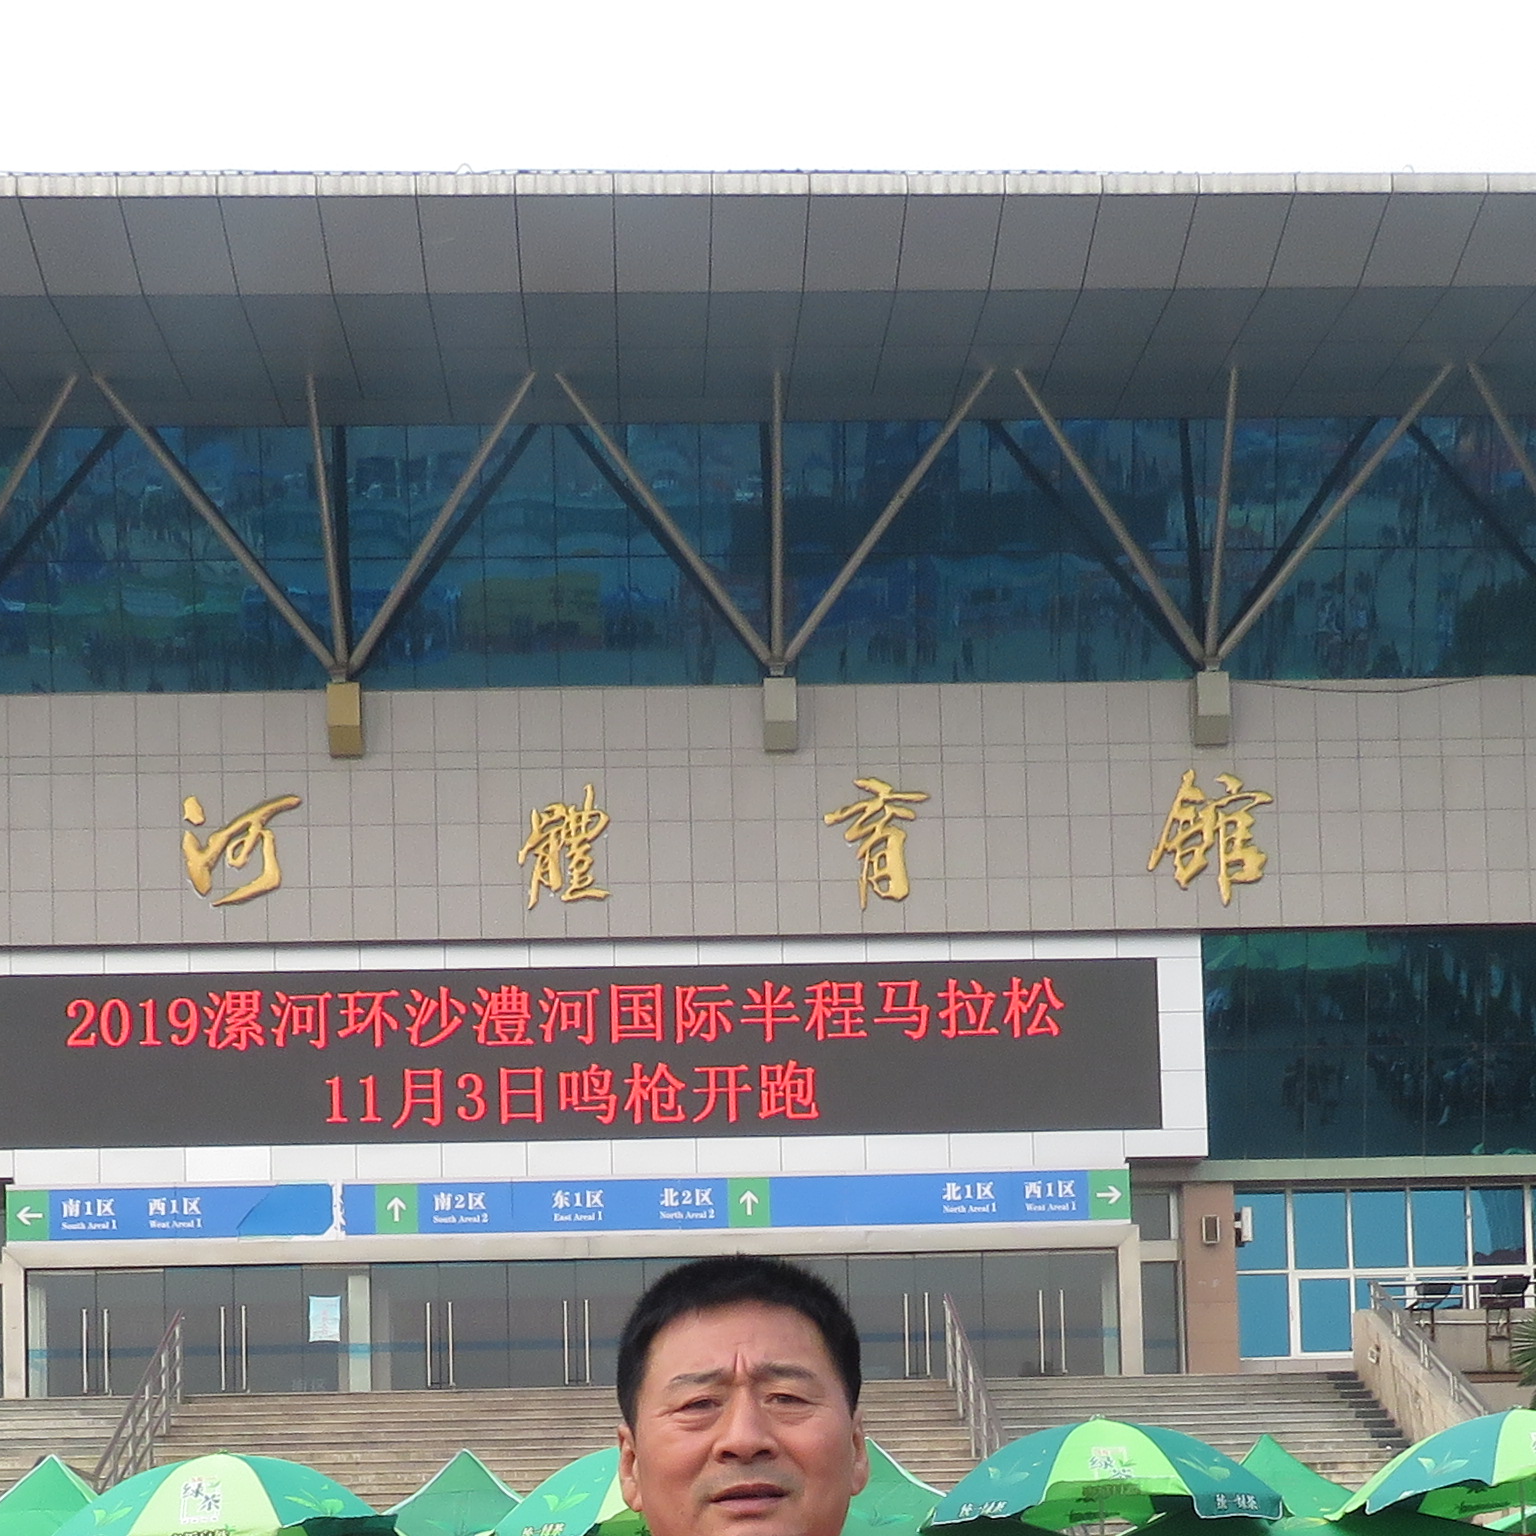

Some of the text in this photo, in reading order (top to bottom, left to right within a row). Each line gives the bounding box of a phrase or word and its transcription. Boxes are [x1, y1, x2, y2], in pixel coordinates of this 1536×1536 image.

[66, 974, 1066, 1051] 2019漯河环沙澧河国际半程马拉松
[322, 1064, 820, 1130] 11月3日鸣枪开跑
[552, 1189, 604, 1208] 东1区
[659, 1187, 714, 1208] 北2区
[942, 1181, 996, 1201] 北1区
[1024, 1180, 1075, 1199] 西1区
[62, 1198, 116, 1217] 南1区
[148, 1197, 202, 1216] 西1区
[432, 1191, 486, 1211] 南2区
